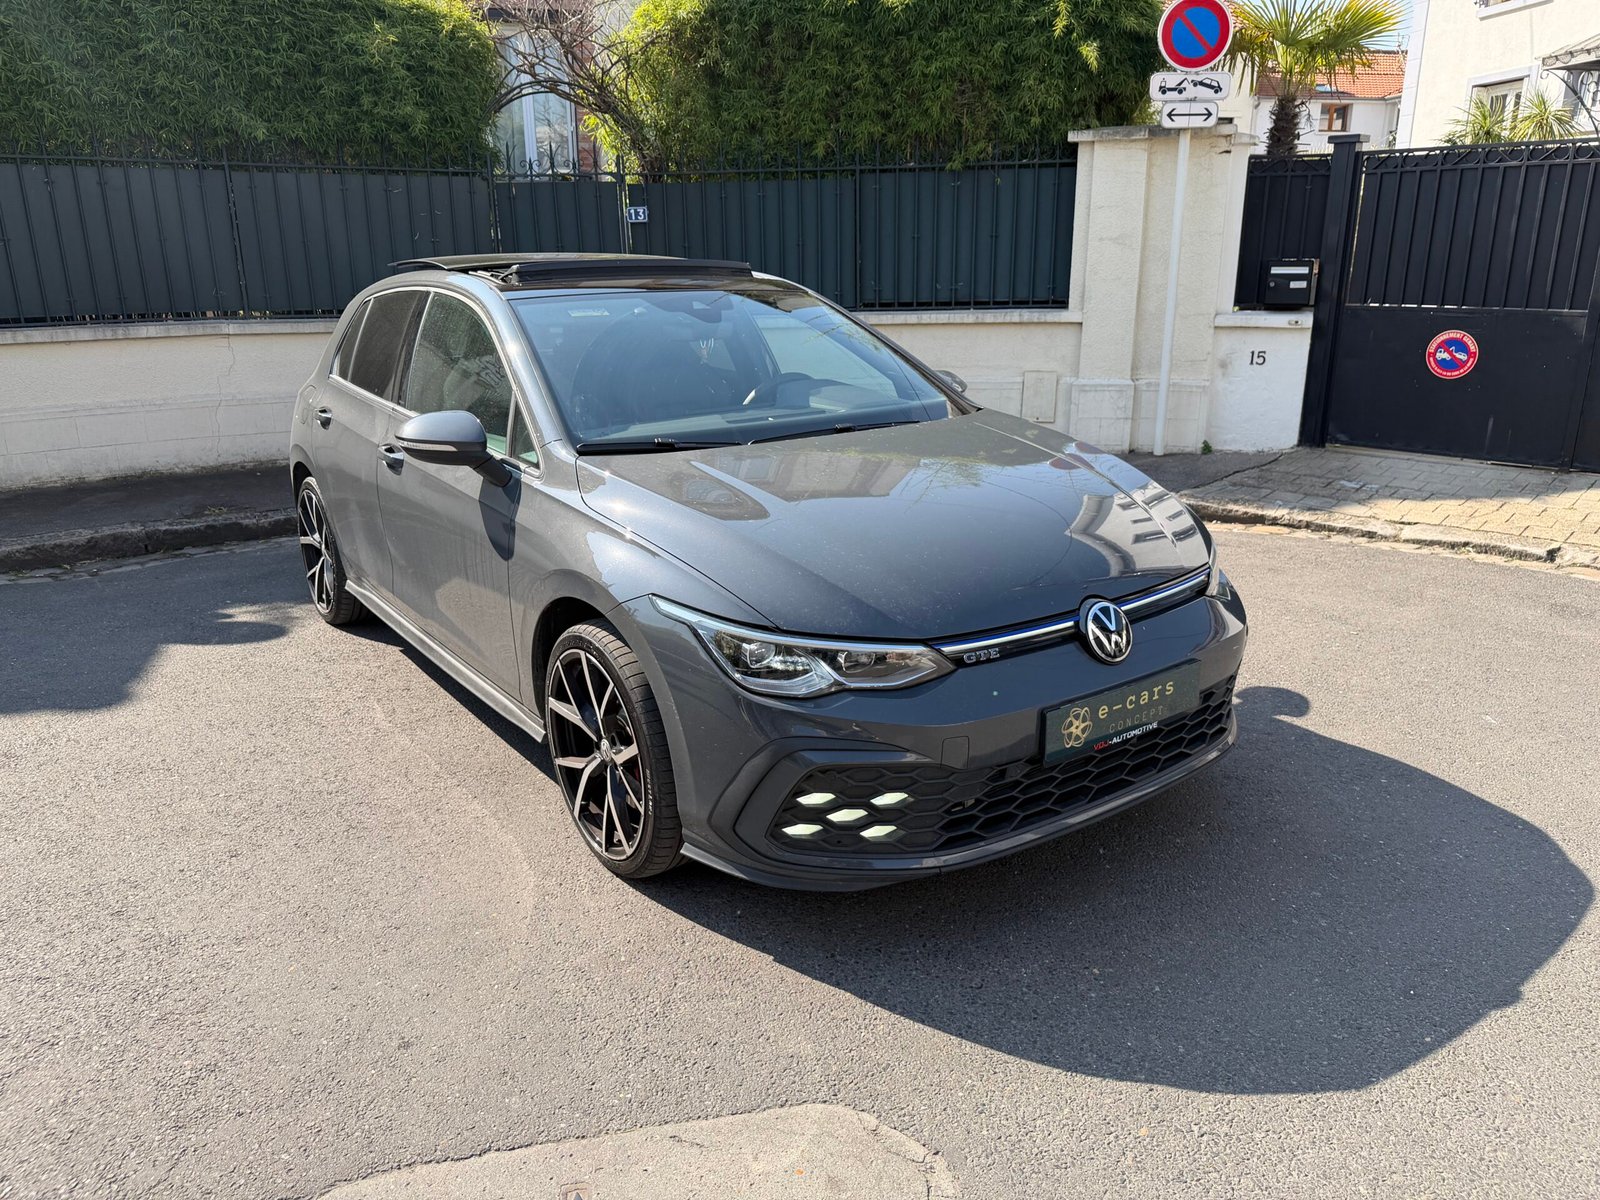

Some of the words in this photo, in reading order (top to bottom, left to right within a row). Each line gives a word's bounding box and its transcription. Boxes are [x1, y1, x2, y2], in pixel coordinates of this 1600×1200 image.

[629, 208, 645, 220] 13
[1249, 350, 1267, 366] 15
[963, 647, 1000, 665] GTE
[1098, 680, 1175, 719] e-cars
[1109, 705, 1163, 733] CONCEPT
